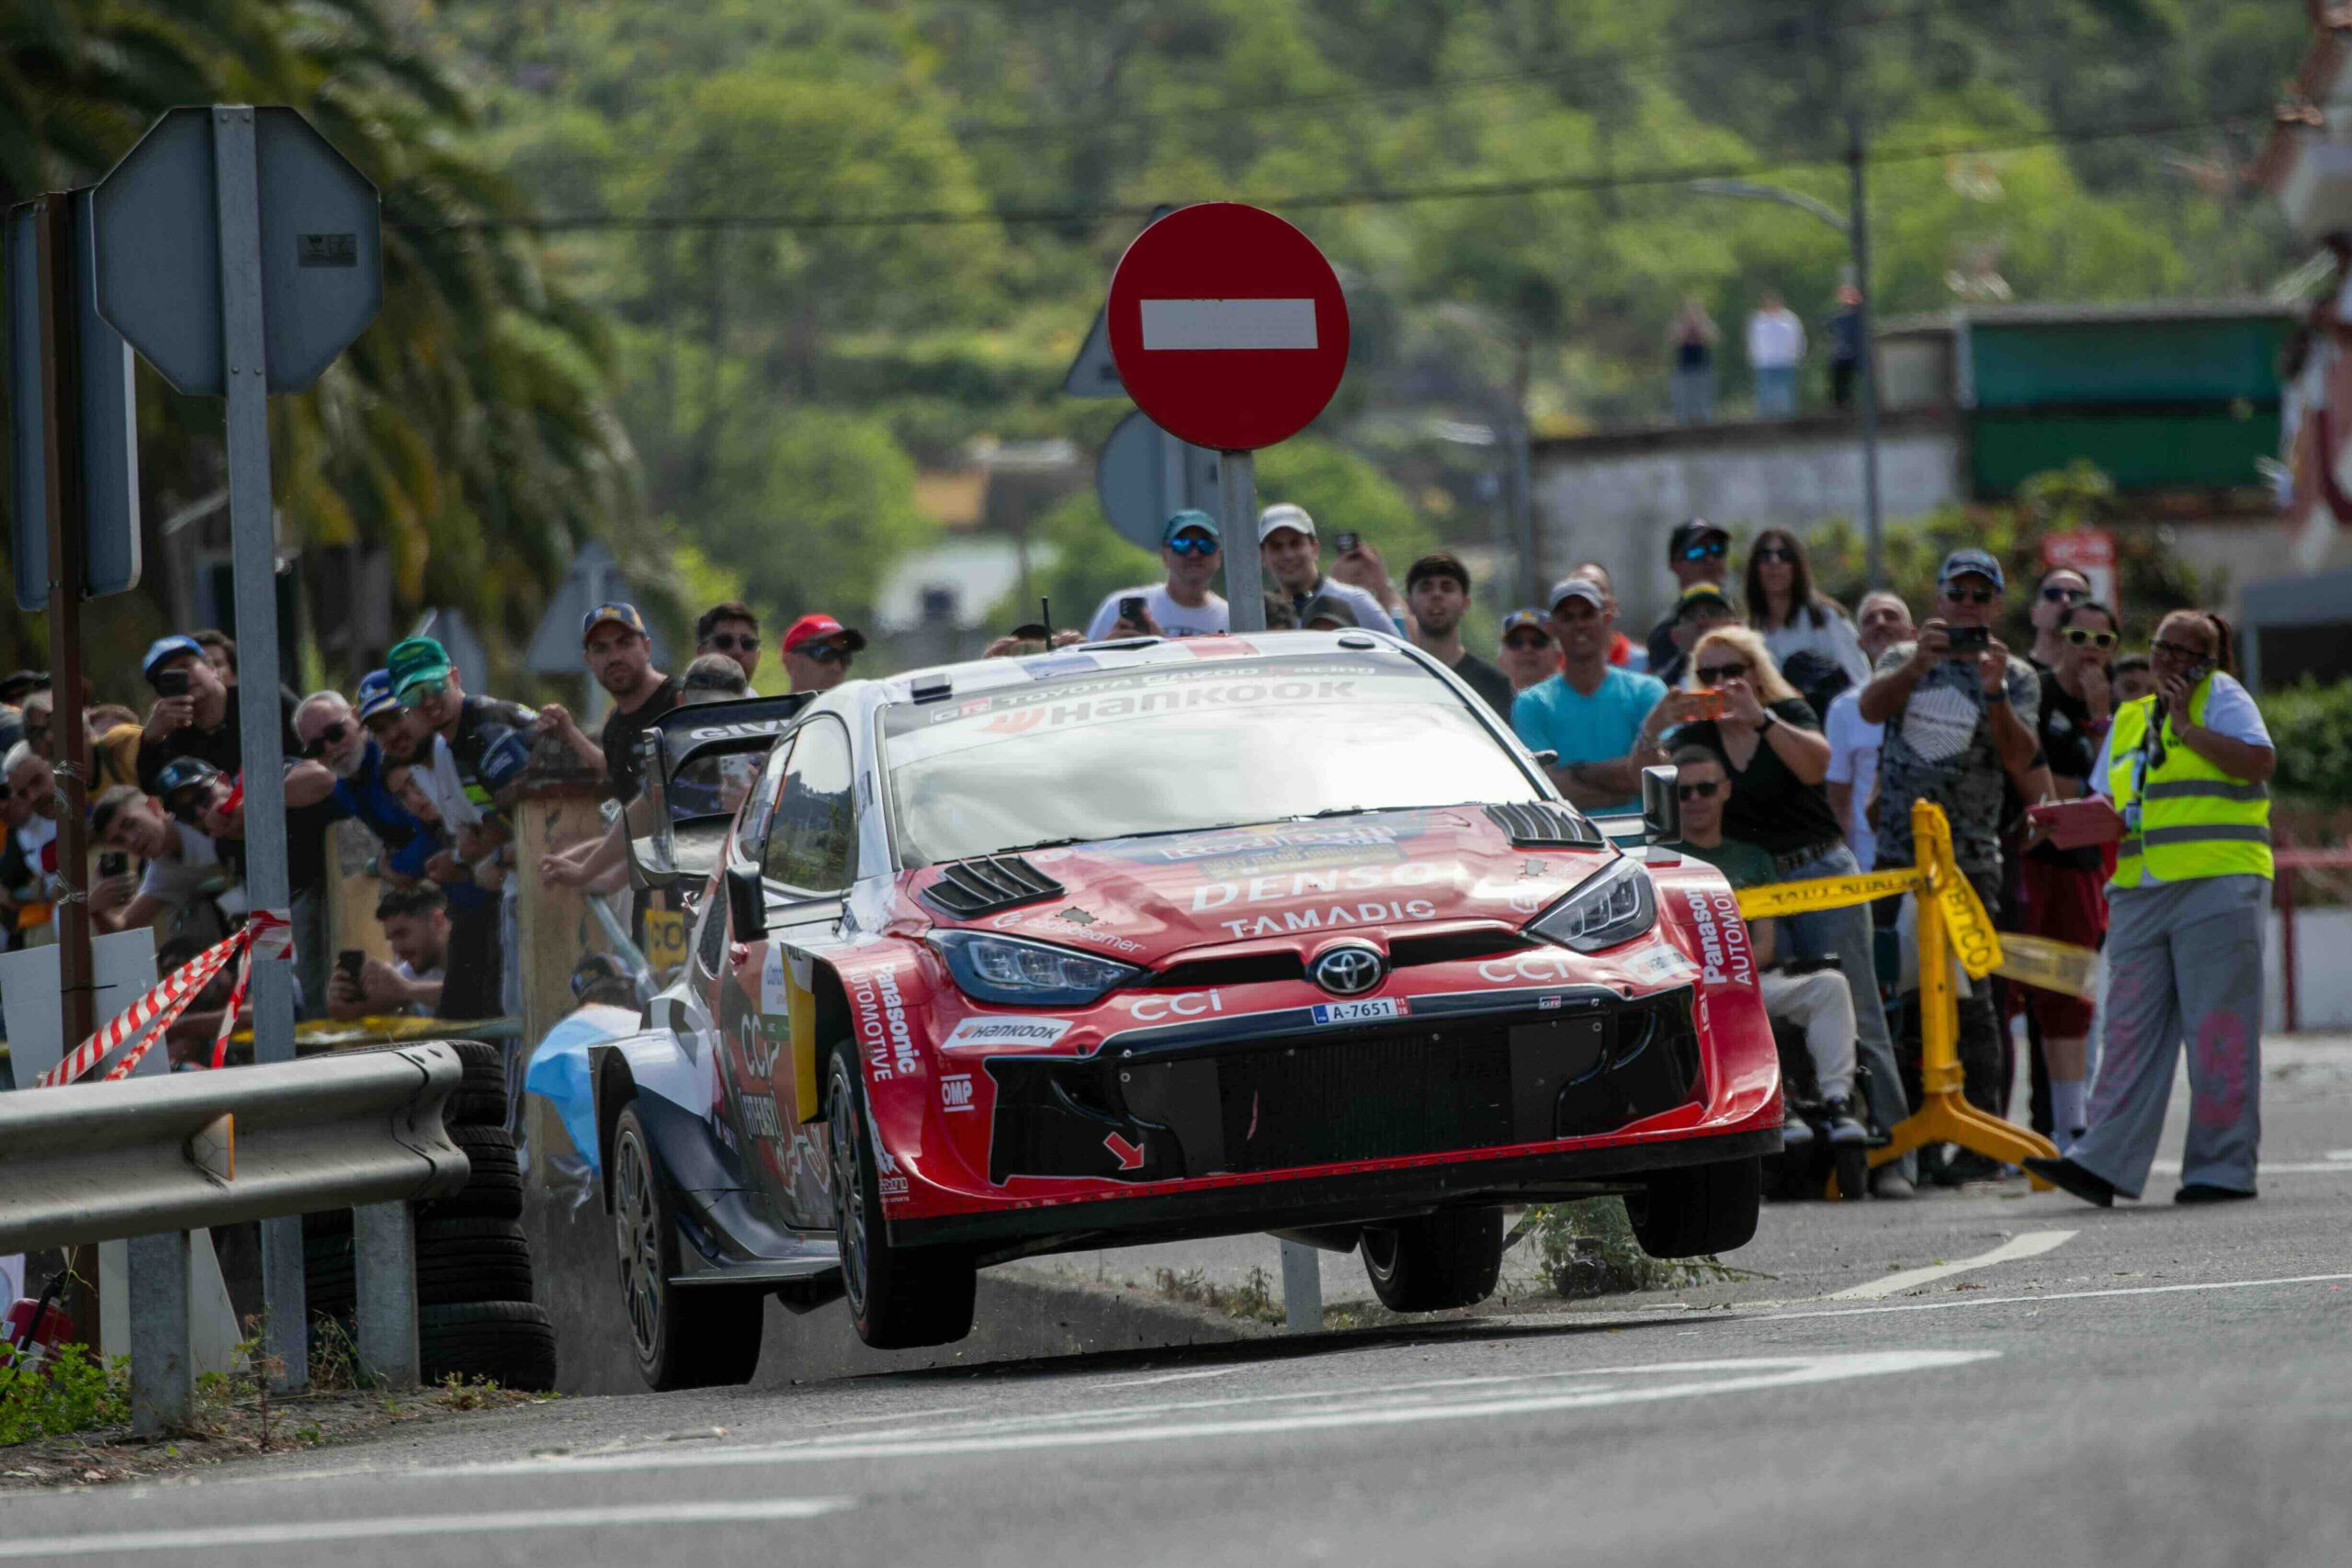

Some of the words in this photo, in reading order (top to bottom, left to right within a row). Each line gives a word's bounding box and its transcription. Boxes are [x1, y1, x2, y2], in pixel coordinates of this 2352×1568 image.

[1002, 680, 1132, 705] TOYOTA
[1192, 862, 1439, 911] DENSO
[1221, 899, 1436, 939] TAMADIC
[875, 963, 920, 1073] Panasonic
[1332, 1001, 1391, 1020] A-7651
[941, 1080, 974, 1106] OMP
